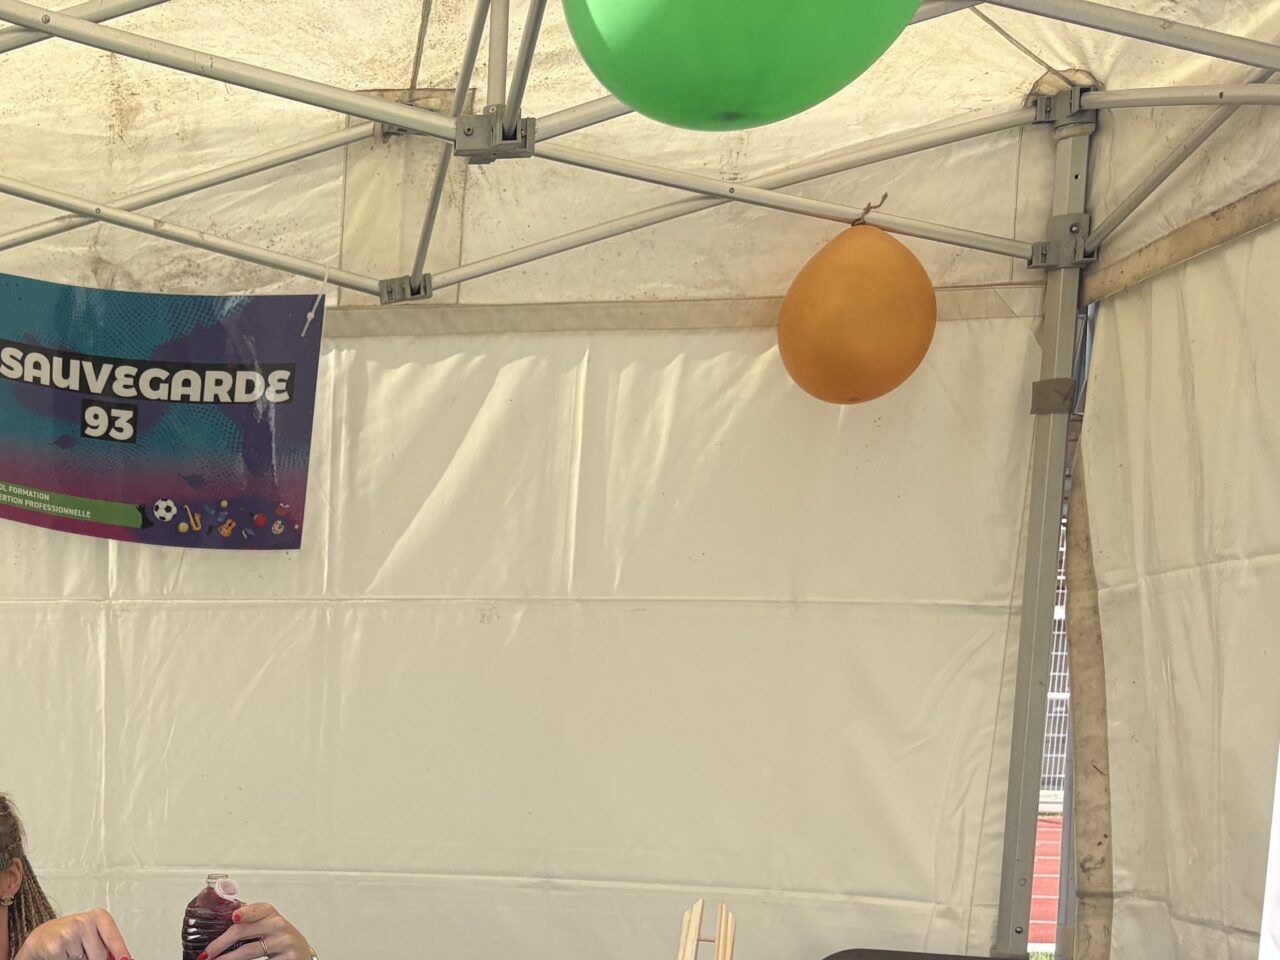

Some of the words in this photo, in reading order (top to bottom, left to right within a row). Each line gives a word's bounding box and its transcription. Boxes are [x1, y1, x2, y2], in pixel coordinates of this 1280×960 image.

[83, 405, 135, 441] 93
[8, 485, 50, 501] FORMATION
[24, 499, 92, 518] PROFESSIONNELLE
